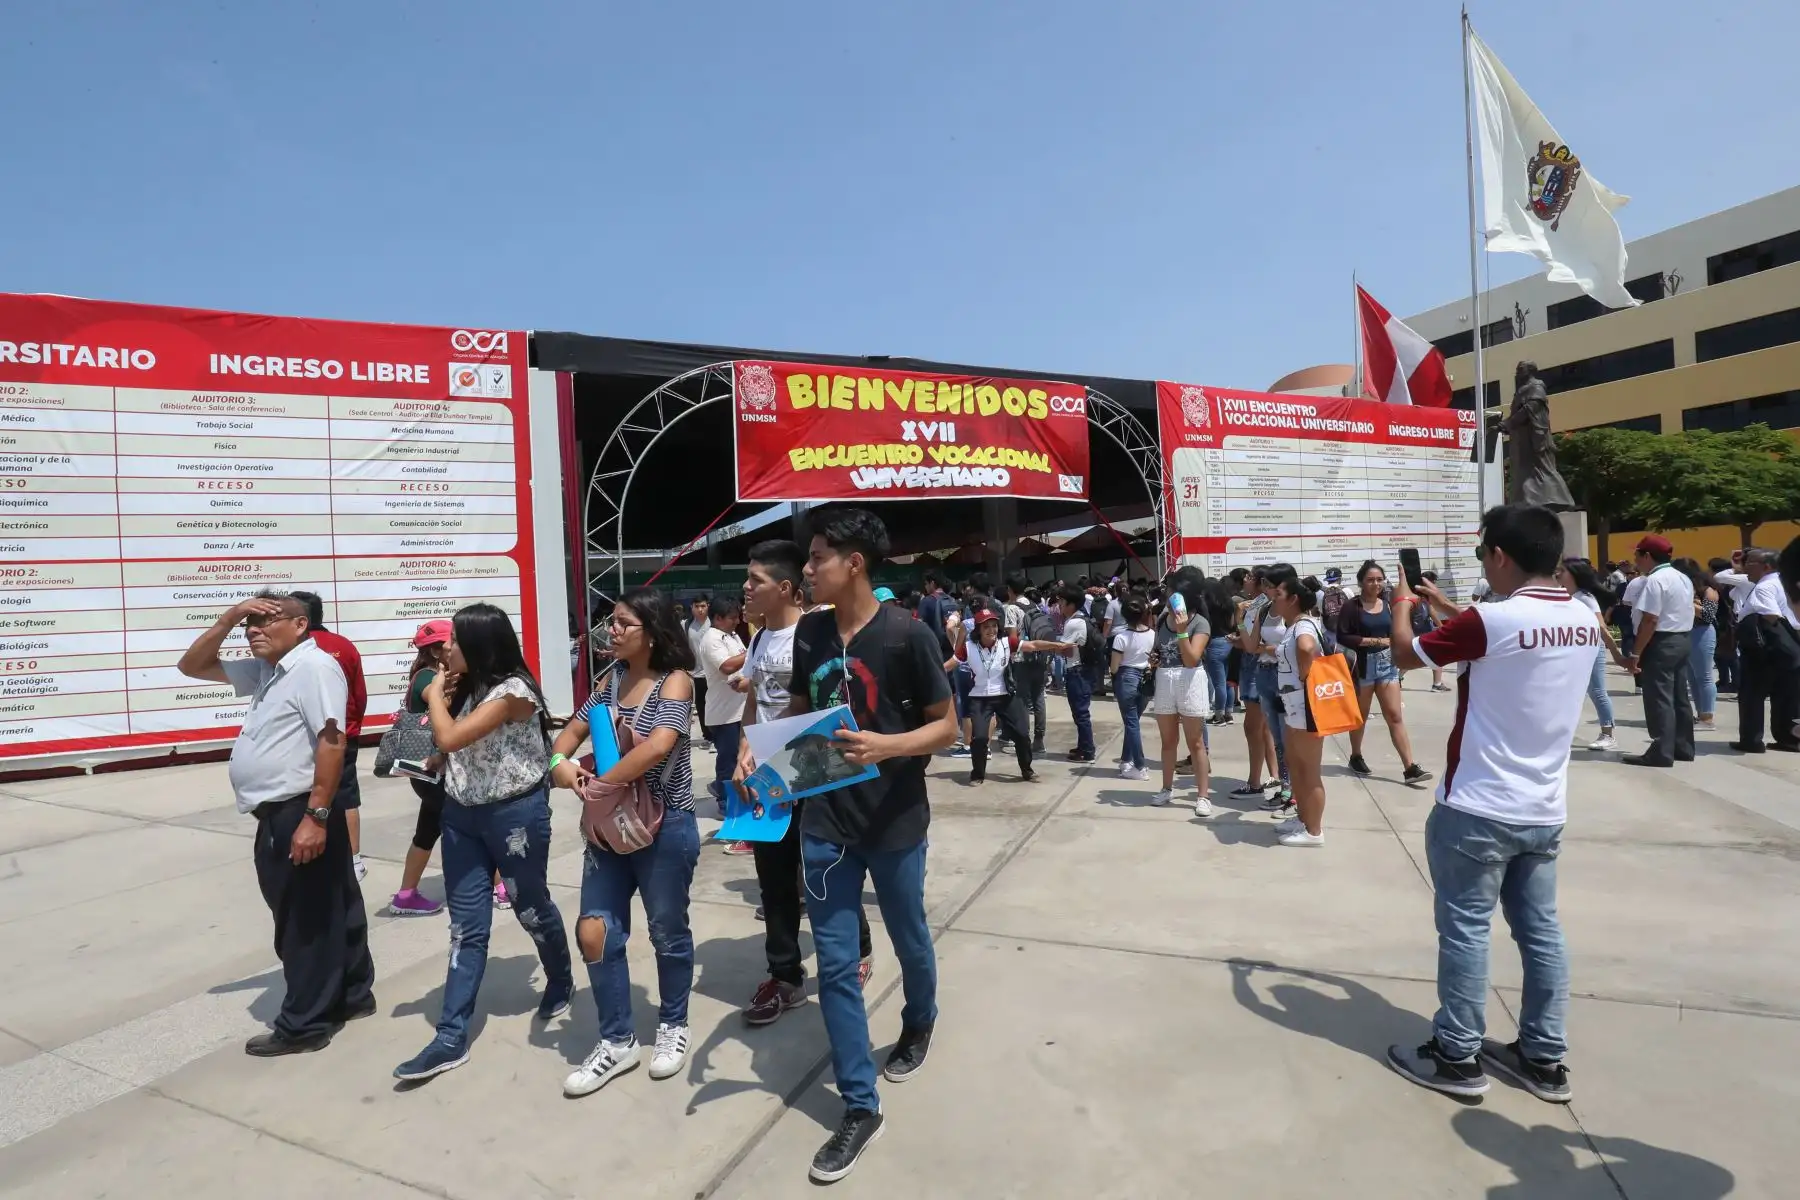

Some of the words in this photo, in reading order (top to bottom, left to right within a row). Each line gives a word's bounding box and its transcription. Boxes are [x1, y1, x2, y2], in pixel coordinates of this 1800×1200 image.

[451, 330, 508, 353] OCA
[0, 341, 156, 370] RSITARIO
[209, 354, 343, 380] INGRESO
[351, 361, 430, 384] LIBRE
[18, 387, 29, 395] 2:
[6, 396, 65, 405] exposiciones)
[191, 394, 245, 404] AUDITORIO
[786, 373, 1049, 420] BIENVENIDOS
[160, 403, 201, 411] (Biblioteca
[237, 405, 286, 413] conferencias)
[393, 402, 441, 411] AUDITORIO
[442, 403, 450, 412] 4:
[1050, 395, 1085, 414] OCA
[1223, 398, 1247, 411] XVII
[1249, 401, 1317, 417] ENCUENTRO
[1, 414, 35, 422] Médica
[741, 413, 777, 423] UNMSM
[1457, 410, 1476, 423] OCA
[196, 421, 227, 430] Trabajo
[228, 421, 253, 429] Social
[1225, 412, 1300, 429] VOCACIONAL
[1301, 417, 1375, 434] UNIVERSITARIO
[391, 427, 423, 435] Medicina
[900, 420, 956, 442] XVII
[1388, 424, 1429, 438] INGRESO
[1430, 427, 1454, 440] LIBRE
[0, 436, 16, 445] ión
[1184, 433, 1213, 443] UNMSM
[425, 447, 460, 455] Industrial
[39, 457, 45, 465] y
[48, 455, 59, 463] de
[61, 456, 71, 464] la
[788, 443, 924, 472] ENCUENTRO
[928, 444, 1052, 474] VOCACIONAL
[177, 463, 233, 472] Investigación
[234, 464, 274, 472] Operativa
[401, 466, 447, 474] Contabilidad
[849, 466, 1010, 489] UNIVERSITARIO
[1181, 476, 1201, 484] JUEVES
[197, 481, 254, 490] RECESO
[400, 483, 449, 492] RECESO
[1183, 484, 1199, 499] 31
[209, 499, 243, 508] Química
[384, 500, 421, 508] Ingeniería
[176, 521, 213, 529] Genética
[389, 520, 439, 528] Comunicación
[441, 519, 462, 527] Social
[237, 541, 255, 549] Arte
[400, 539, 454, 547] Administración
[198, 564, 251, 573] AUDITORIO
[253, 564, 262, 573] 3:
[400, 560, 446, 569] AUDITORIO
[448, 560, 456, 568] 4:
[28, 569, 39, 577] 2:
[474, 567, 499, 575] Temple)
[16, 577, 75, 587] exposiciones)
[167, 574, 208, 582] (Biblioteca
[243, 572, 293, 581] conferencias)
[172, 590, 228, 600] Conservación
[443, 607, 461, 615] Mina
[13, 619, 56, 628] Software
[0, 641, 49, 651] Biológicas
[0, 660, 38, 671] ESO
[7, 677, 54, 687] Geológica
[2, 685, 59, 695] Metalúrgica
